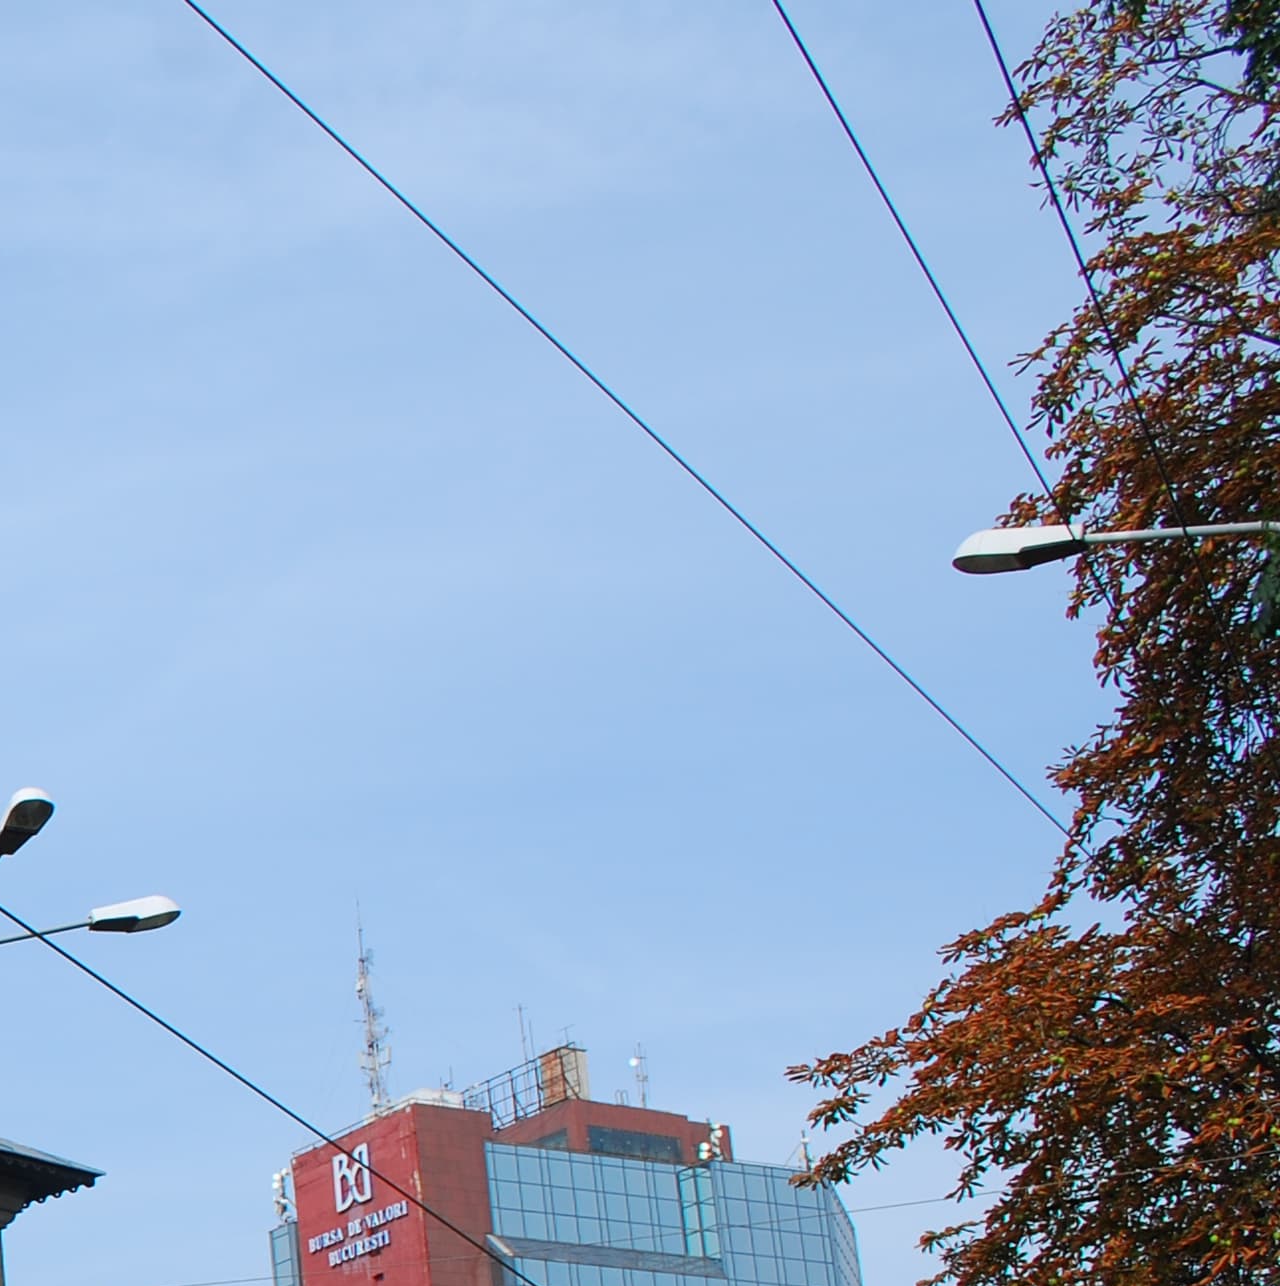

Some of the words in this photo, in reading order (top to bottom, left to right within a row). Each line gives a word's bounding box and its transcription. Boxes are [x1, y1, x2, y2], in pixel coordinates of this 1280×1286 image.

[308, 1227, 345, 1254] BURSA
[347, 1217, 363, 1238] DE
[363, 1200, 409, 1229] VALORI
